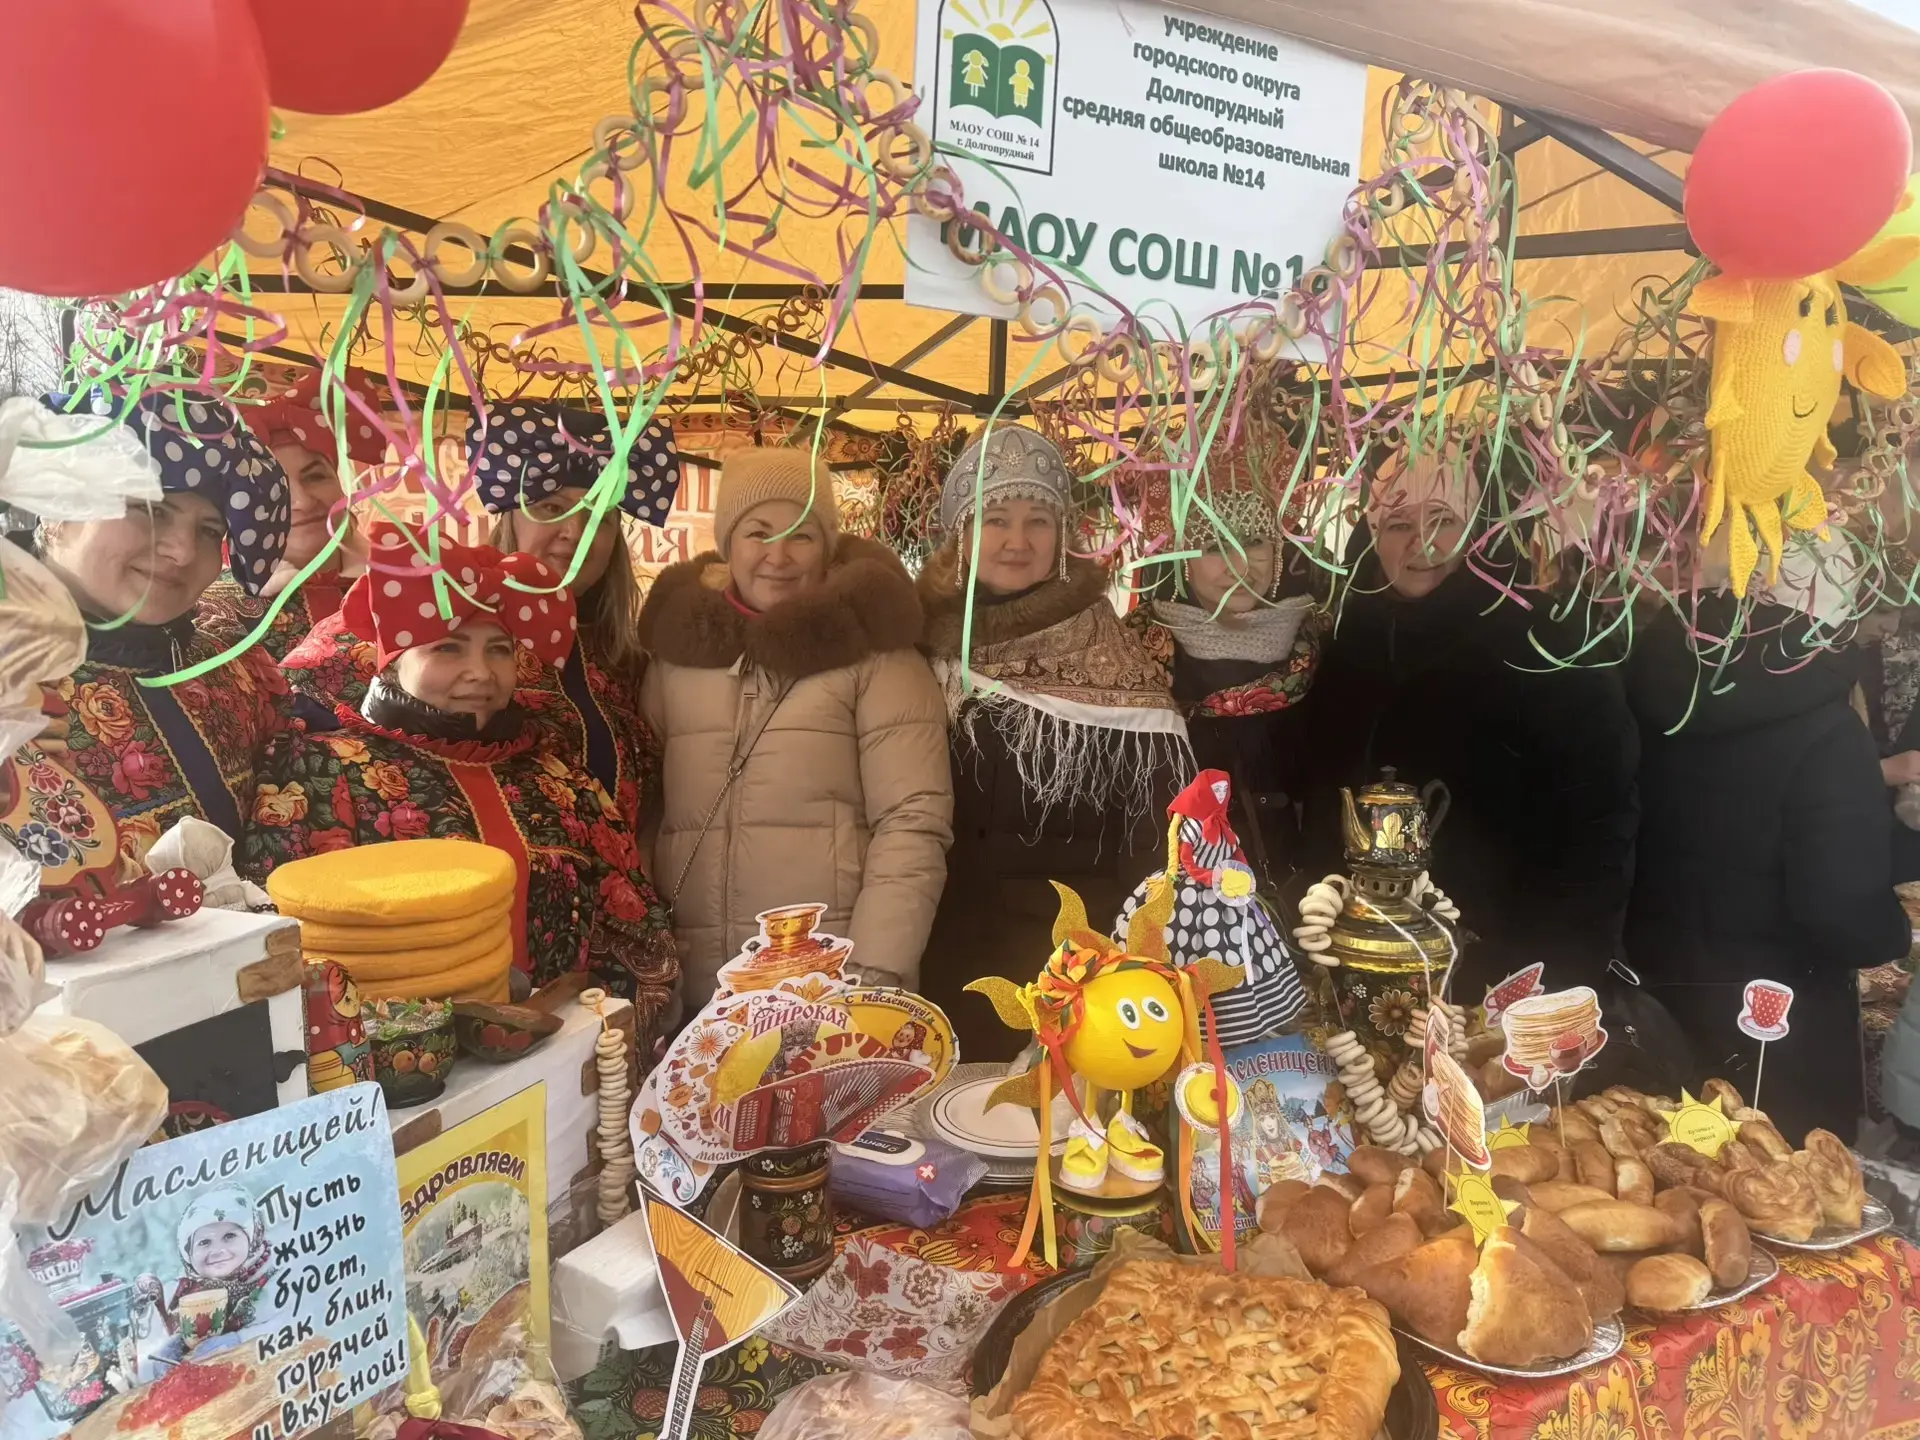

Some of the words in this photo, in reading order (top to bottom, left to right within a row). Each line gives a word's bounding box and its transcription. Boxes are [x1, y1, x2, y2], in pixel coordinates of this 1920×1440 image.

[1163, 14, 1279, 62] учреждение
[1133, 40, 1238, 85] городского
[1242, 69, 1301, 101] округа
[1145, 77, 1285, 129] Долгопрудный
[950, 119, 985, 136] МАОУ
[986, 127, 1014, 143] СОШ
[1029, 137, 1040, 148] 14
[957, 138, 964, 147] г.
[964, 138, 1035, 161] Долгопрудный
[1062, 94, 1146, 130] средняя
[1149, 115, 1350, 177] общеобразовательная
[1158, 150, 1218, 179] школа
[1222, 164, 1266, 191] №14
[1108, 228, 1218, 290] СОШ
[750, 1004, 849, 1041] ШИРОКАЯ
[861, 993, 931, 1020] Масленицей!
[48, 1087, 381, 1241] Масленицей!
[258, 1174, 362, 1229] Пусть
[274, 1215, 366, 1266] жизнь
[275, 1255, 367, 1316] будет,
[259, 1316, 313, 1361] как
[325, 1279, 393, 1328] блин,
[278, 1315, 389, 1396] горячей
